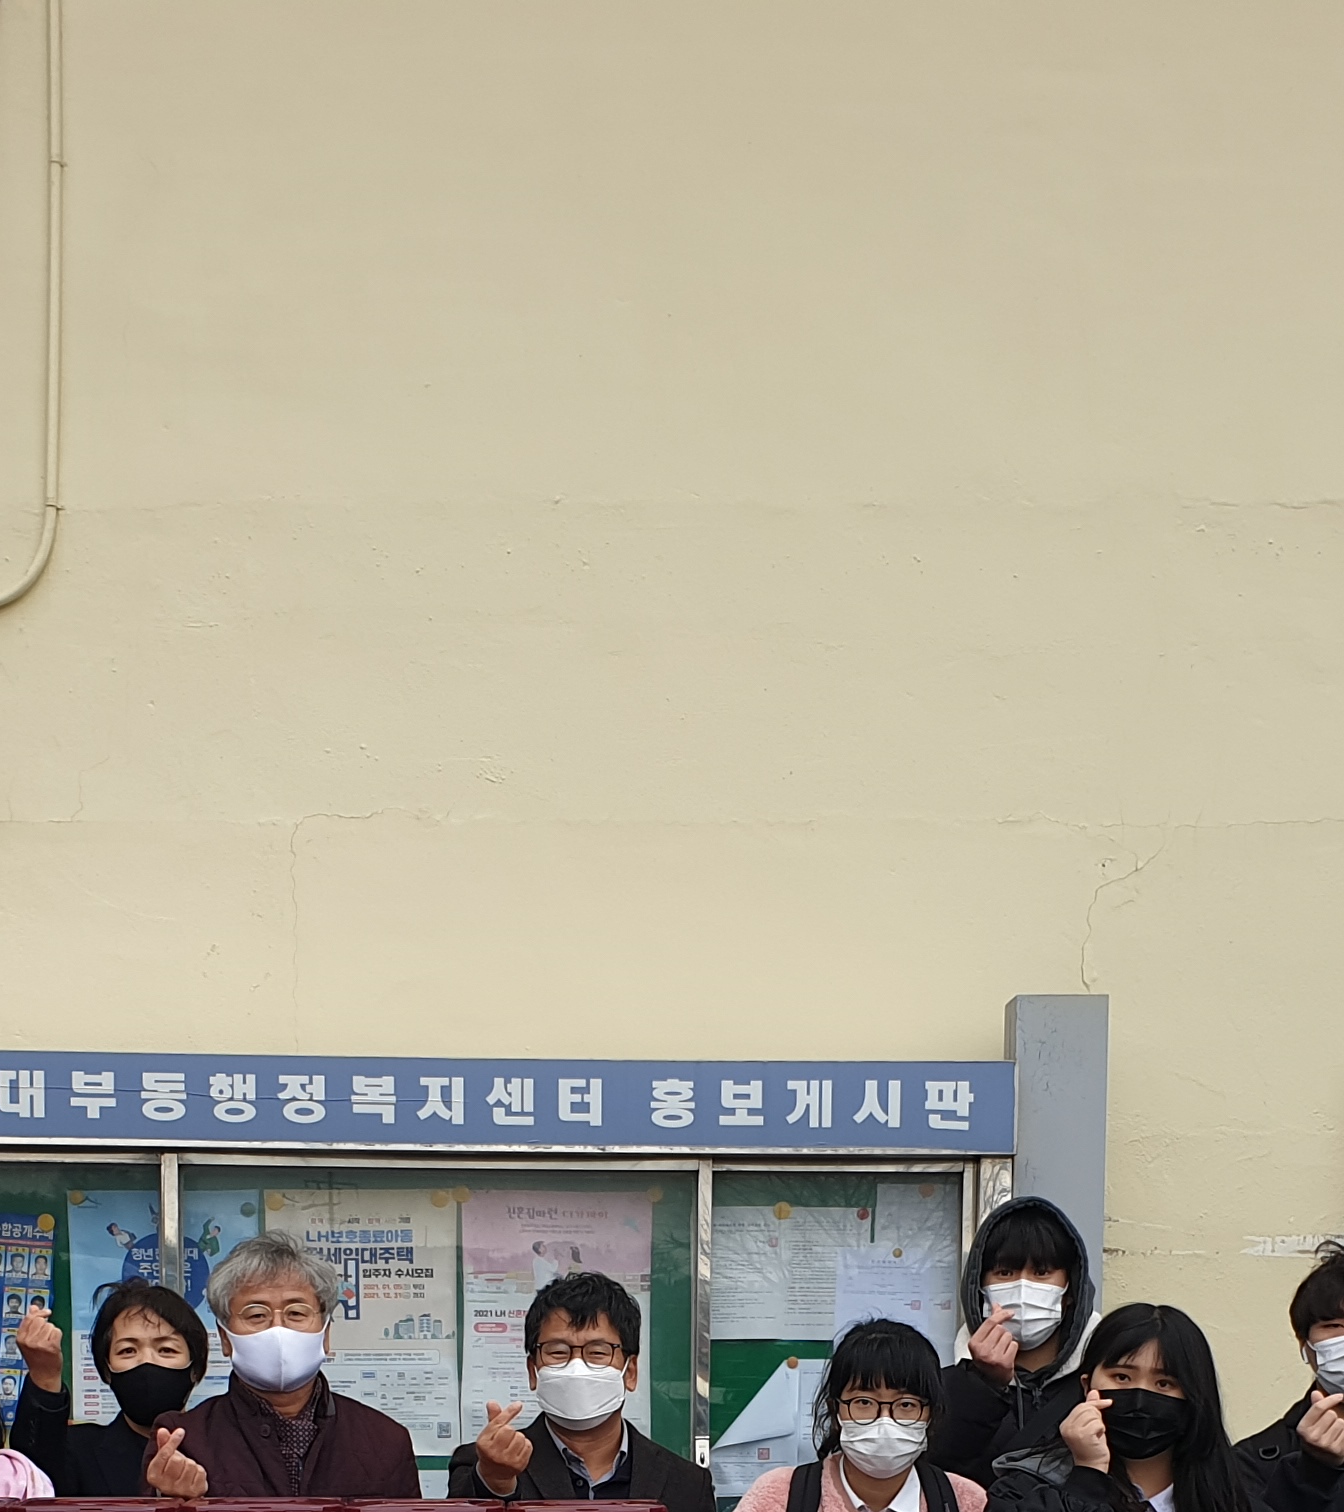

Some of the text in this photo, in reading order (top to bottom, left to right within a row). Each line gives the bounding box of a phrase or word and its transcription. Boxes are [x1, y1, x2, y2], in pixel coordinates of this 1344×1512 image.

[650, 1079, 974, 1131] 홍보게시판
[362, 1268, 434, 1278] 입주자 수시모집
[474, 1310, 493, 1318] 2021
